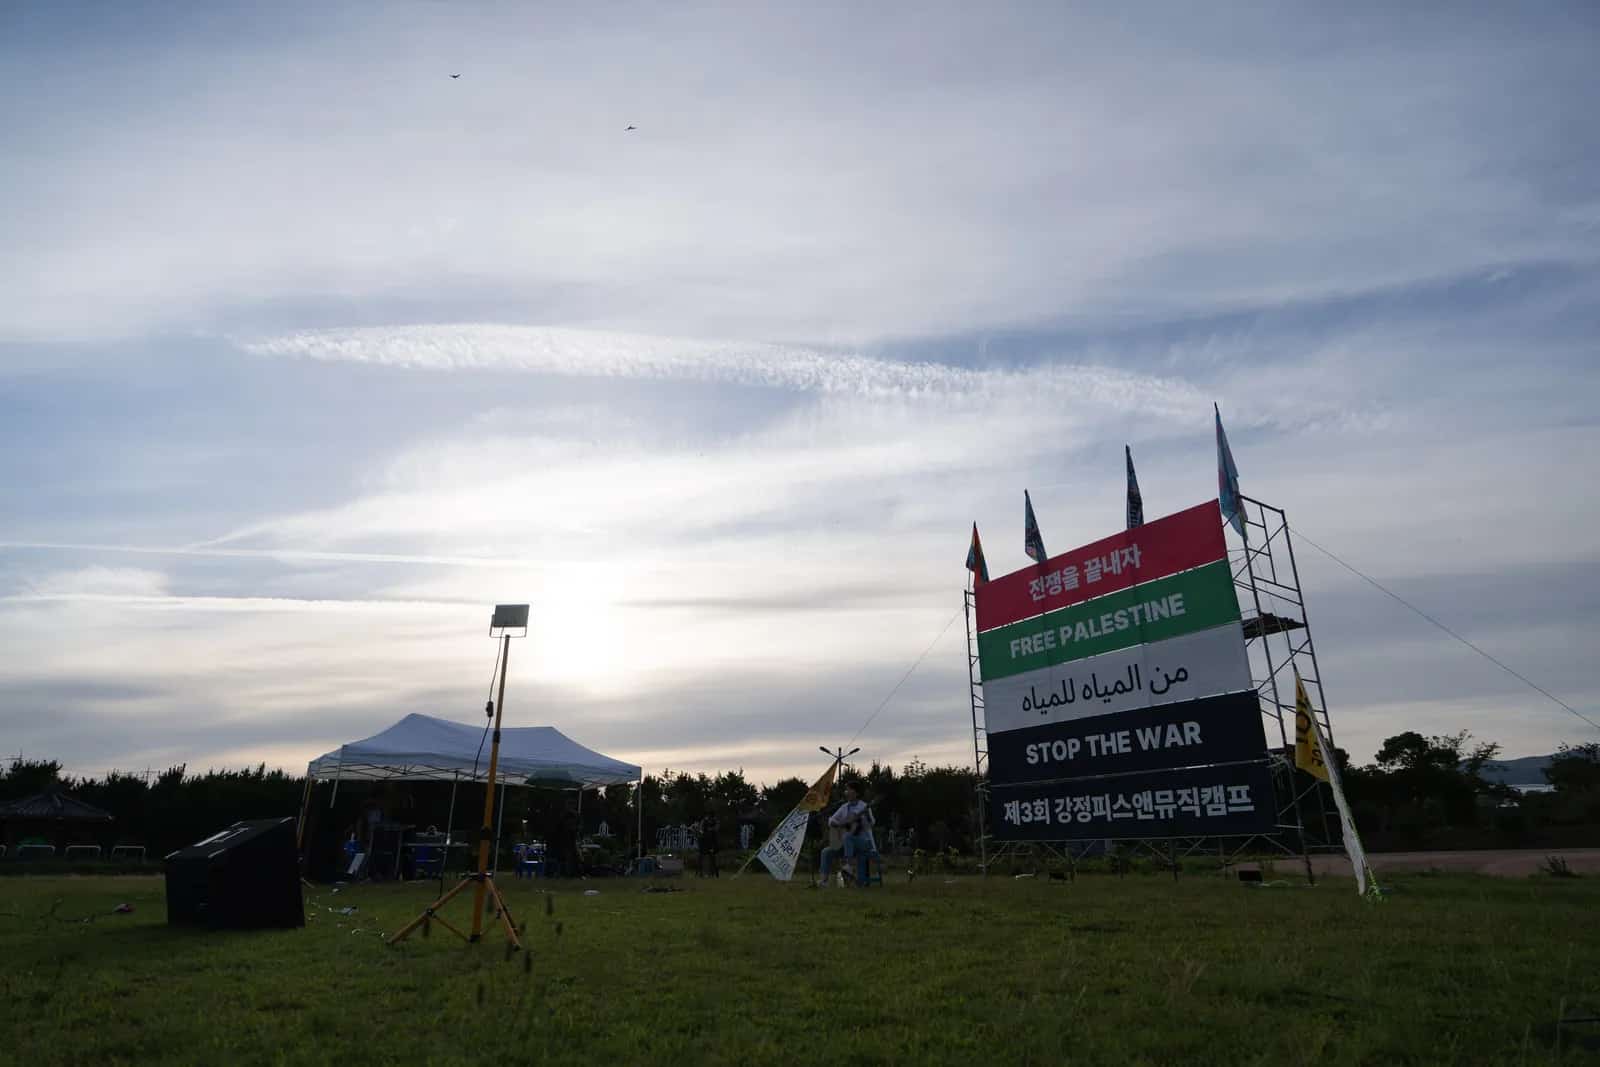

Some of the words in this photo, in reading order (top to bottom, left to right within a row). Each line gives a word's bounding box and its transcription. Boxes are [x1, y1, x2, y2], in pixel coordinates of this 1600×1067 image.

[1029, 565, 1080, 602] 전쟁을
[1084, 543, 1142, 584] 끝내자
[1009, 629, 1057, 659] FREE
[1059, 593, 1186, 646] PALESTINE
[1022, 677, 1076, 714] للمياه
[1082, 663, 1142, 703] المياه
[1150, 666, 1188, 694] من
[1025, 738, 1081, 765] STOP
[1085, 730, 1132, 757] THE
[1136, 721, 1203, 750] WAR
[1003, 798, 1050, 825] 제3회
[1055, 784, 1255, 824] 강정피스앤뮤직캠프
